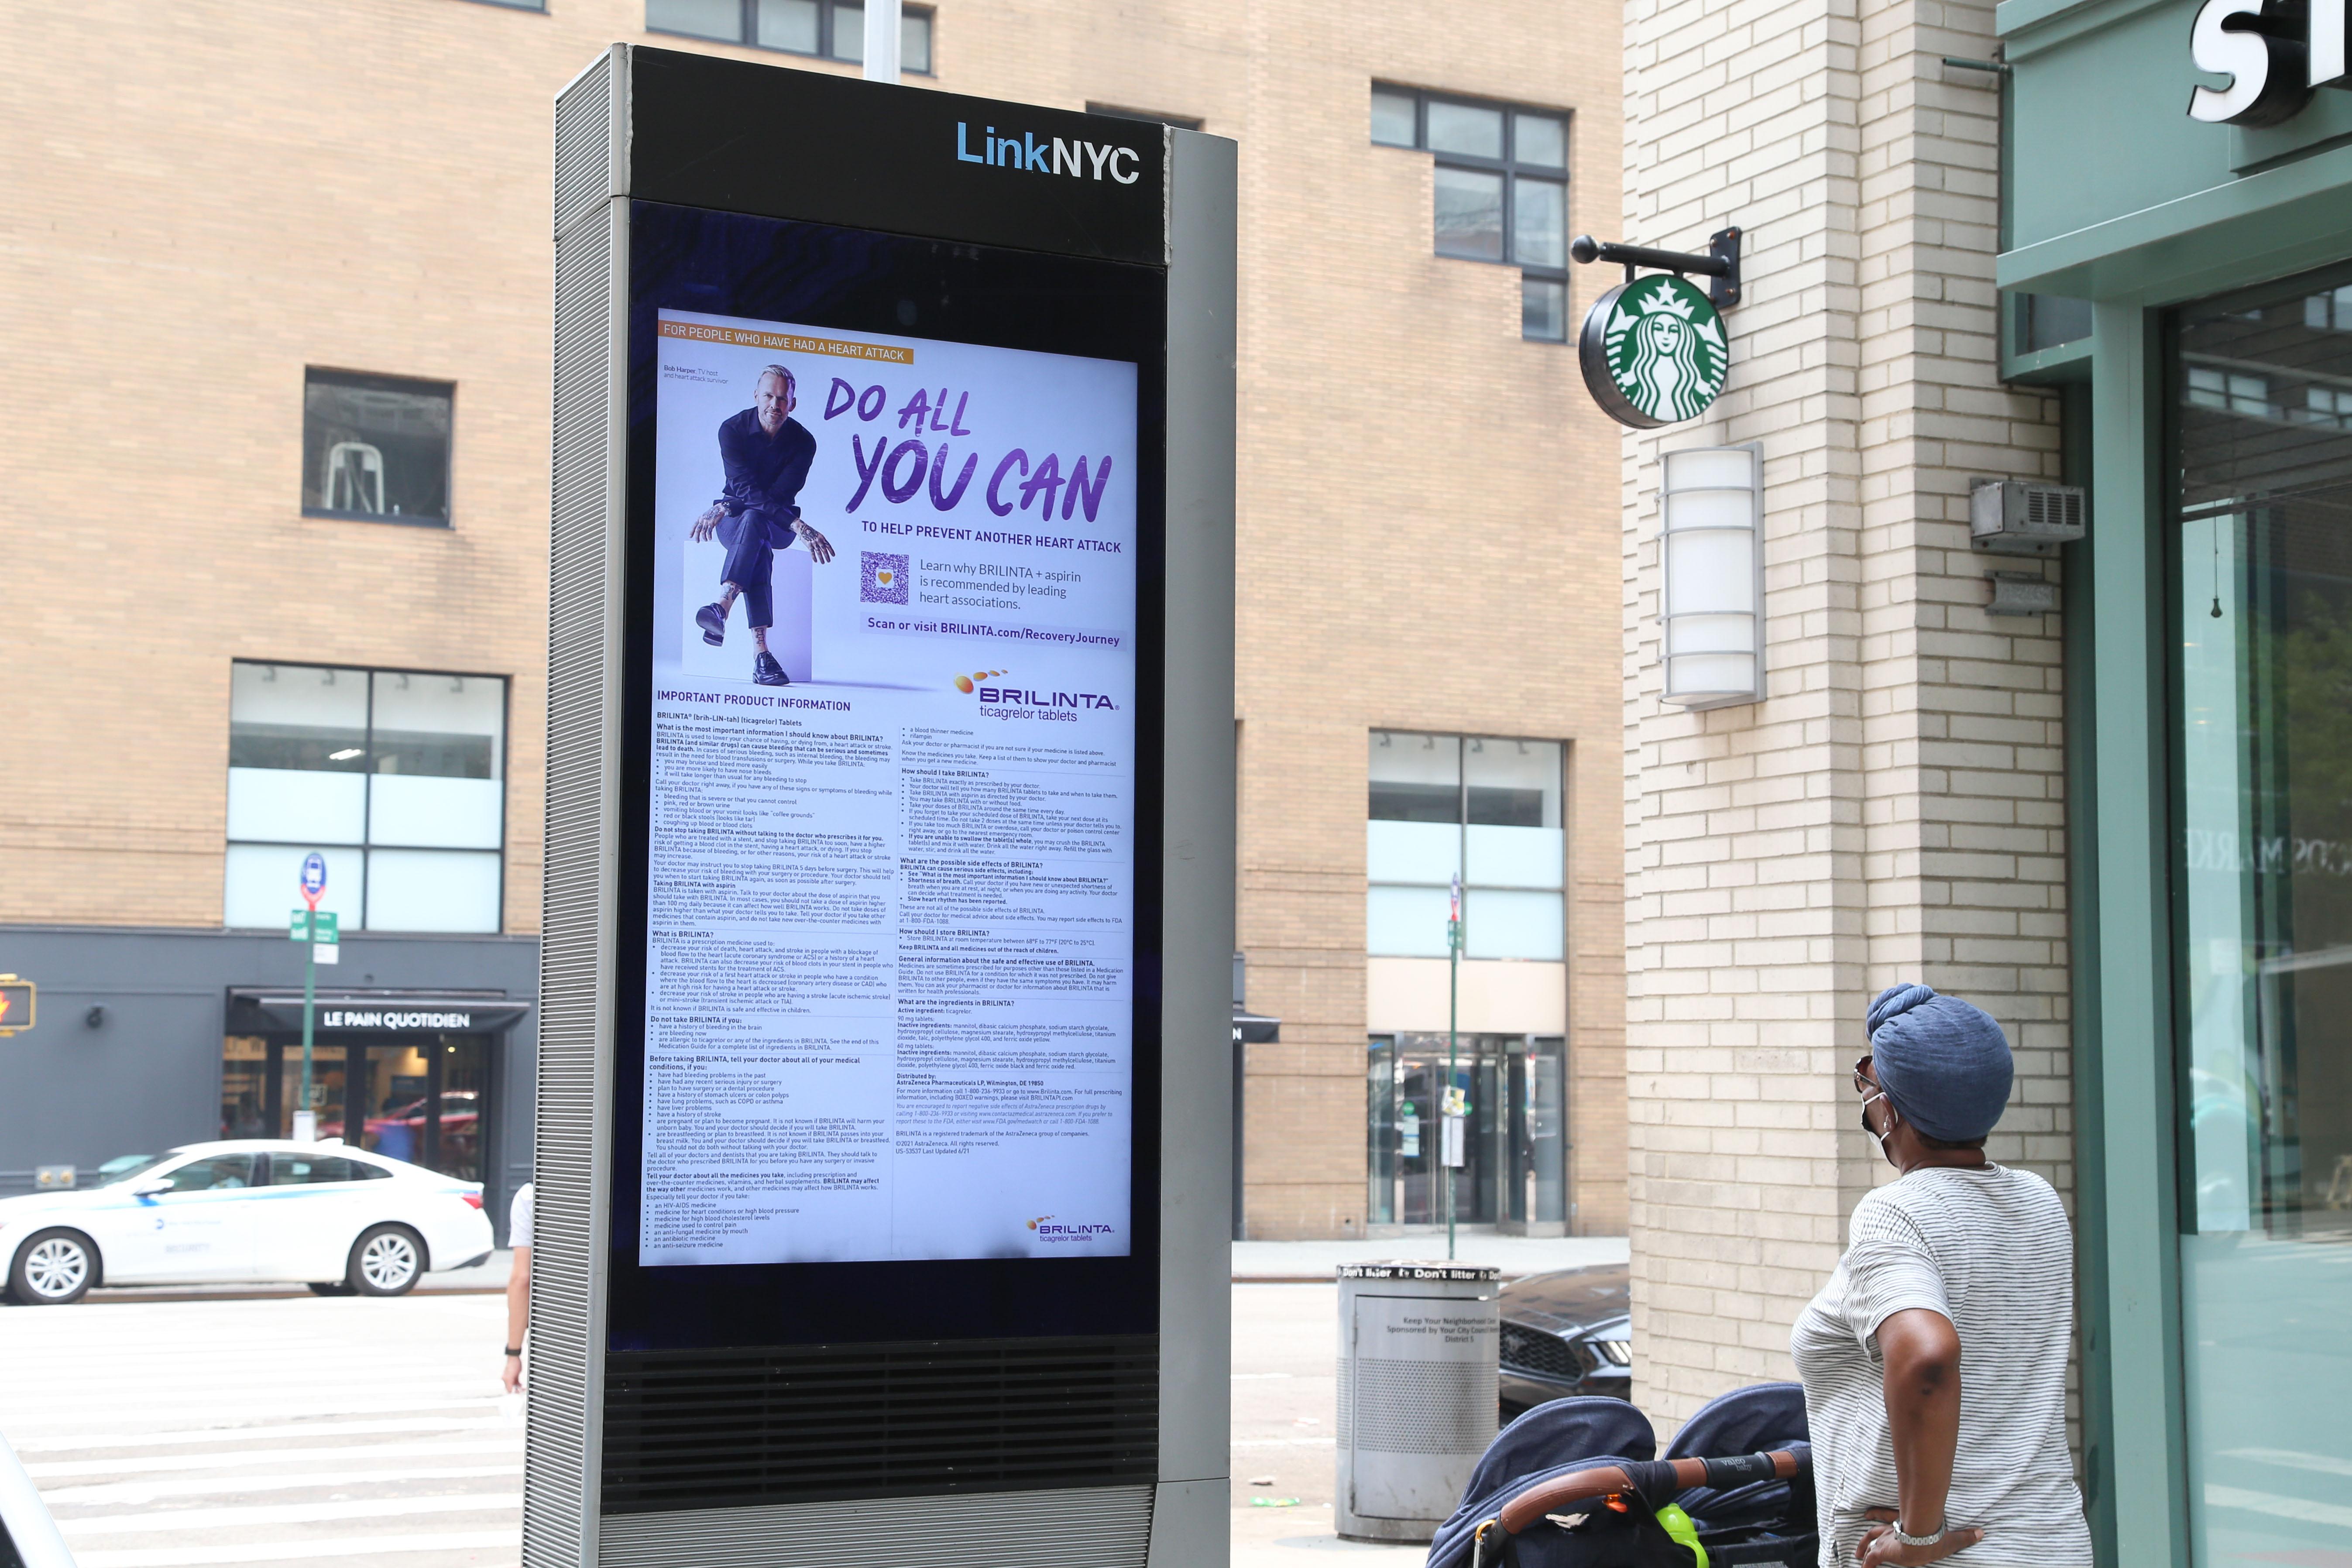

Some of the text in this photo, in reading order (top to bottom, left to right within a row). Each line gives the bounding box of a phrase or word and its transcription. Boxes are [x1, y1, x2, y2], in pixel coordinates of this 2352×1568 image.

[958, 122, 1140, 184] LinkNYC
[664, 324, 904, 360] FOR PEOPLE WHO HAVE HAD A HEART ATTACK
[676, 366, 696, 374] Harper,
[824, 377, 972, 436] DO ALL
[845, 433, 1112, 522] YOU CAN
[862, 520, 1121, 553] TO HELP PREVENT ANOTHER HEART ATTACK
[920, 559, 951, 572] Learn
[953, 562, 976, 576] why
[979, 563, 1034, 579] BRILINTA
[1044, 570, 1081, 583] aspirin
[920, 575, 1067, 600] is recommended by leading
[920, 591, 1020, 610] heart associations.
[868, 617, 895, 629] Scan
[913, 621, 937, 632] visit
[941, 622, 1120, 648] BRILINTA.com/RecoveryJourney
[657, 690, 850, 711] IMPORTANT PRODUCT INFORMATION
[979, 705, 1077, 722] ticagrelor tablets
[713, 726, 745, 734] important
[850, 734, 883, 742] BRILINTA?
[324, 1012, 470, 1029] LE PAIN QUOTIDIEN
[673, 1055, 694, 1064] taking
[1040, 1235, 1069, 1243] ticagrelor
[1343, 1268, 1363, 1277] Don't
[1414, 1268, 1447, 1279] Don't
[1451, 1269, 1476, 1280] litter
[1736, 1463, 1752, 1472] baby
